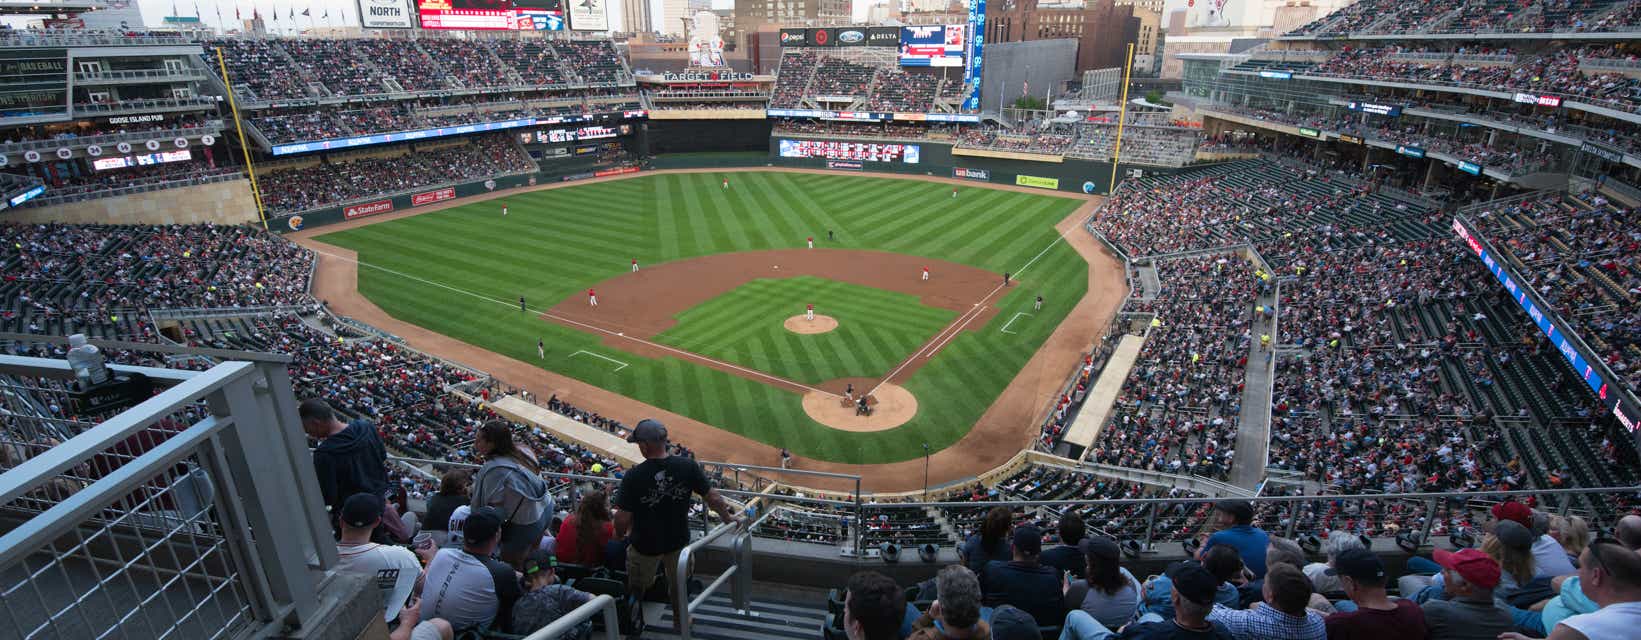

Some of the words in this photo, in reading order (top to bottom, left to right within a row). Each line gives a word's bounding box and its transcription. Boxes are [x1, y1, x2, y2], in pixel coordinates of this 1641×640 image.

[370, 6, 400, 16] NORTH
[664, 72, 709, 81] TARGET
[720, 72, 753, 81] FIELD
[129, 115, 151, 123] ISLAND
